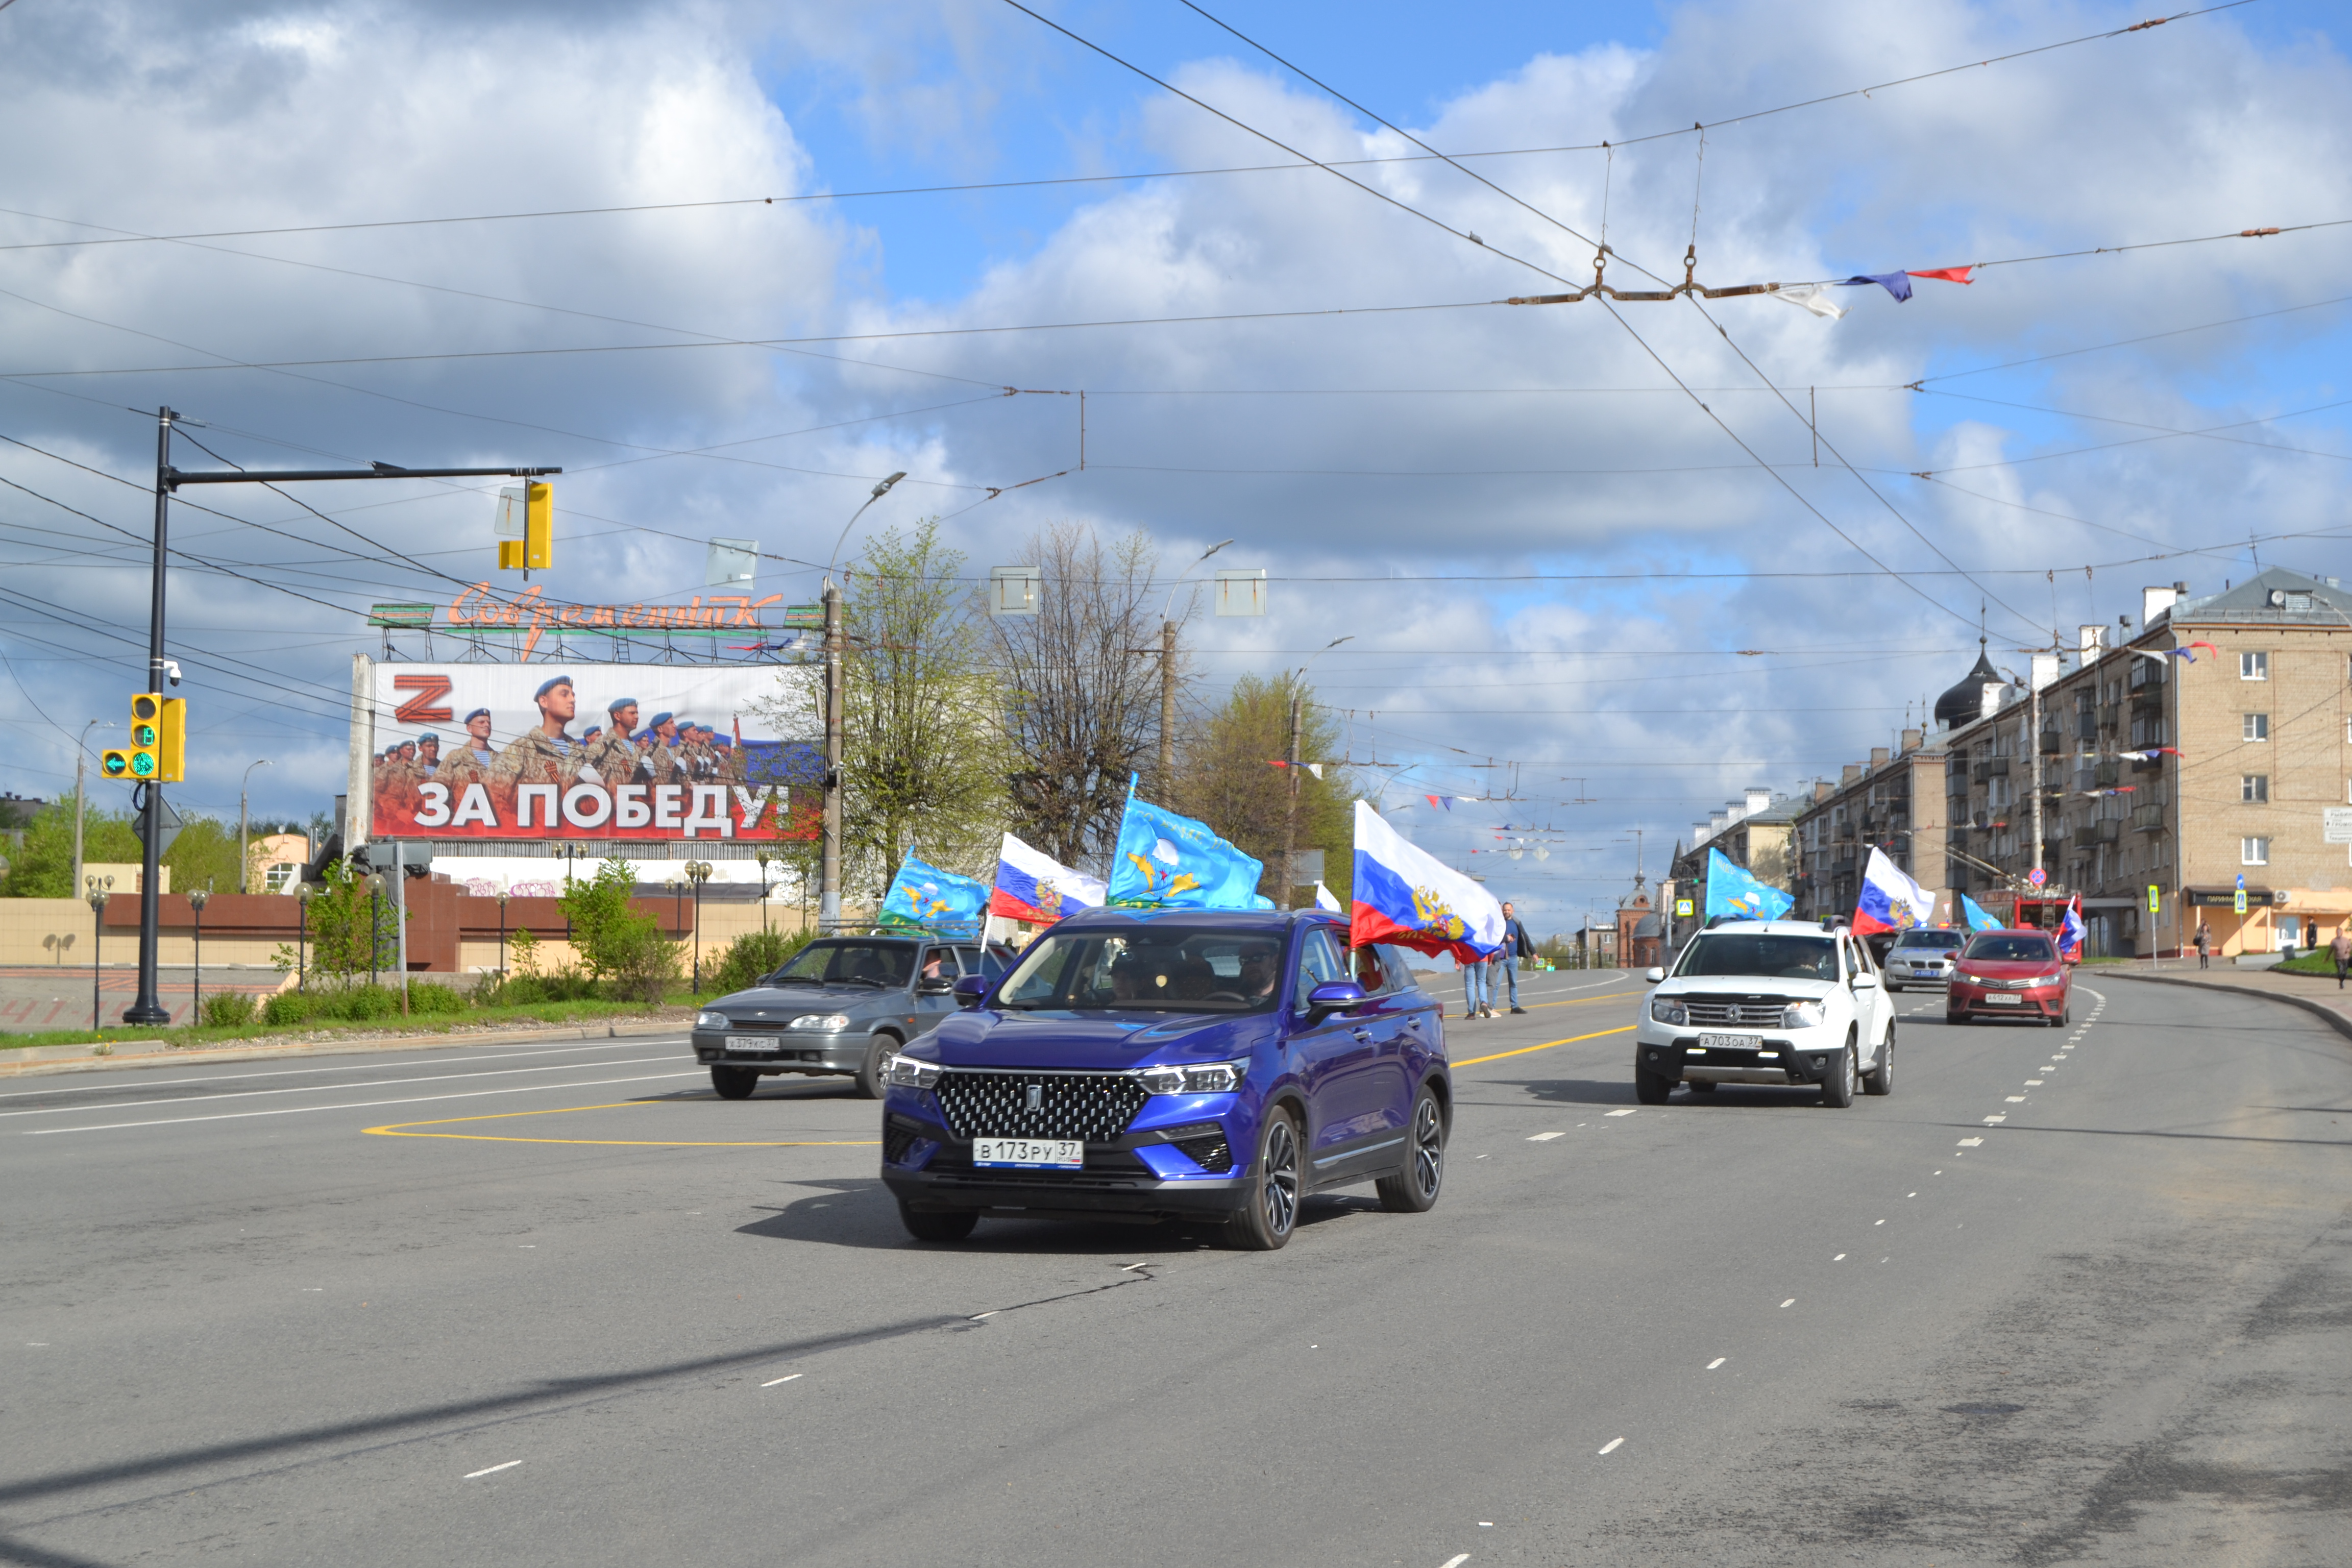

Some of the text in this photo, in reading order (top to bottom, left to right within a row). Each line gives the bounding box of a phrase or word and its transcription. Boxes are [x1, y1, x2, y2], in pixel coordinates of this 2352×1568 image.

[143, 727, 154, 745] 19
[414, 782, 497, 827] ЗА
[1748, 1036, 1759, 1045] 37
[1059, 1142, 1076, 1157] 37
